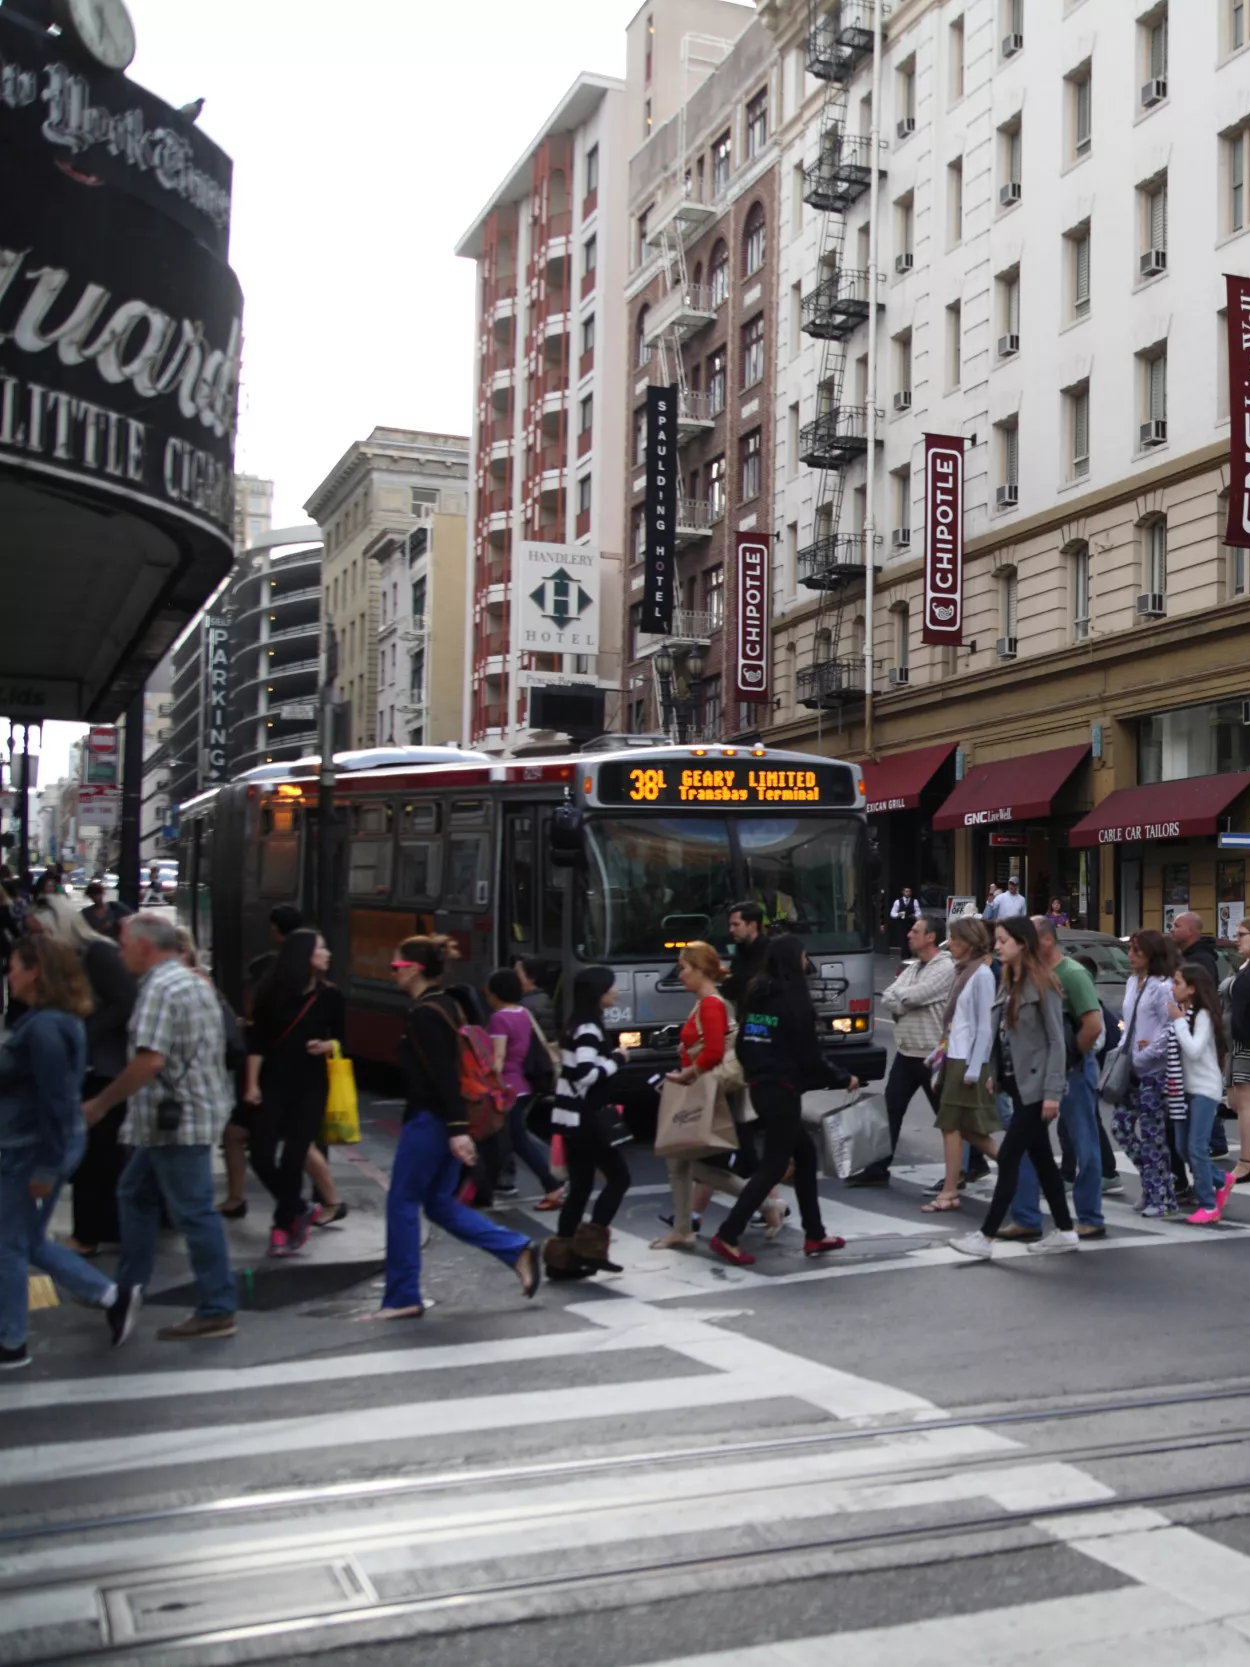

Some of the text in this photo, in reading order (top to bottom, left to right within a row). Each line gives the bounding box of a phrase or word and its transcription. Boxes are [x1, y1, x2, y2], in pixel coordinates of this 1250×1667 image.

[0, 374, 147, 482] LITTLE
[655, 401, 667, 617] SPAULDING HOTEL
[935, 458, 954, 588] CHIPOTLE
[528, 550, 594, 566] HANDLERY
[745, 551, 760, 656] CHIPOTLE
[525, 630, 594, 646] HOTEL
[211, 630, 229, 766] PARKING
[681, 770, 735, 787] GEARY
[748, 771, 816, 787] LIMITED
[678, 786, 819, 800] Transbay Terminal
[866, 798, 905, 813] EXICAN GRILL
[964, 810, 987, 826] GNC
[1098, 821, 1180, 843] CABLE CAR TAILORS
